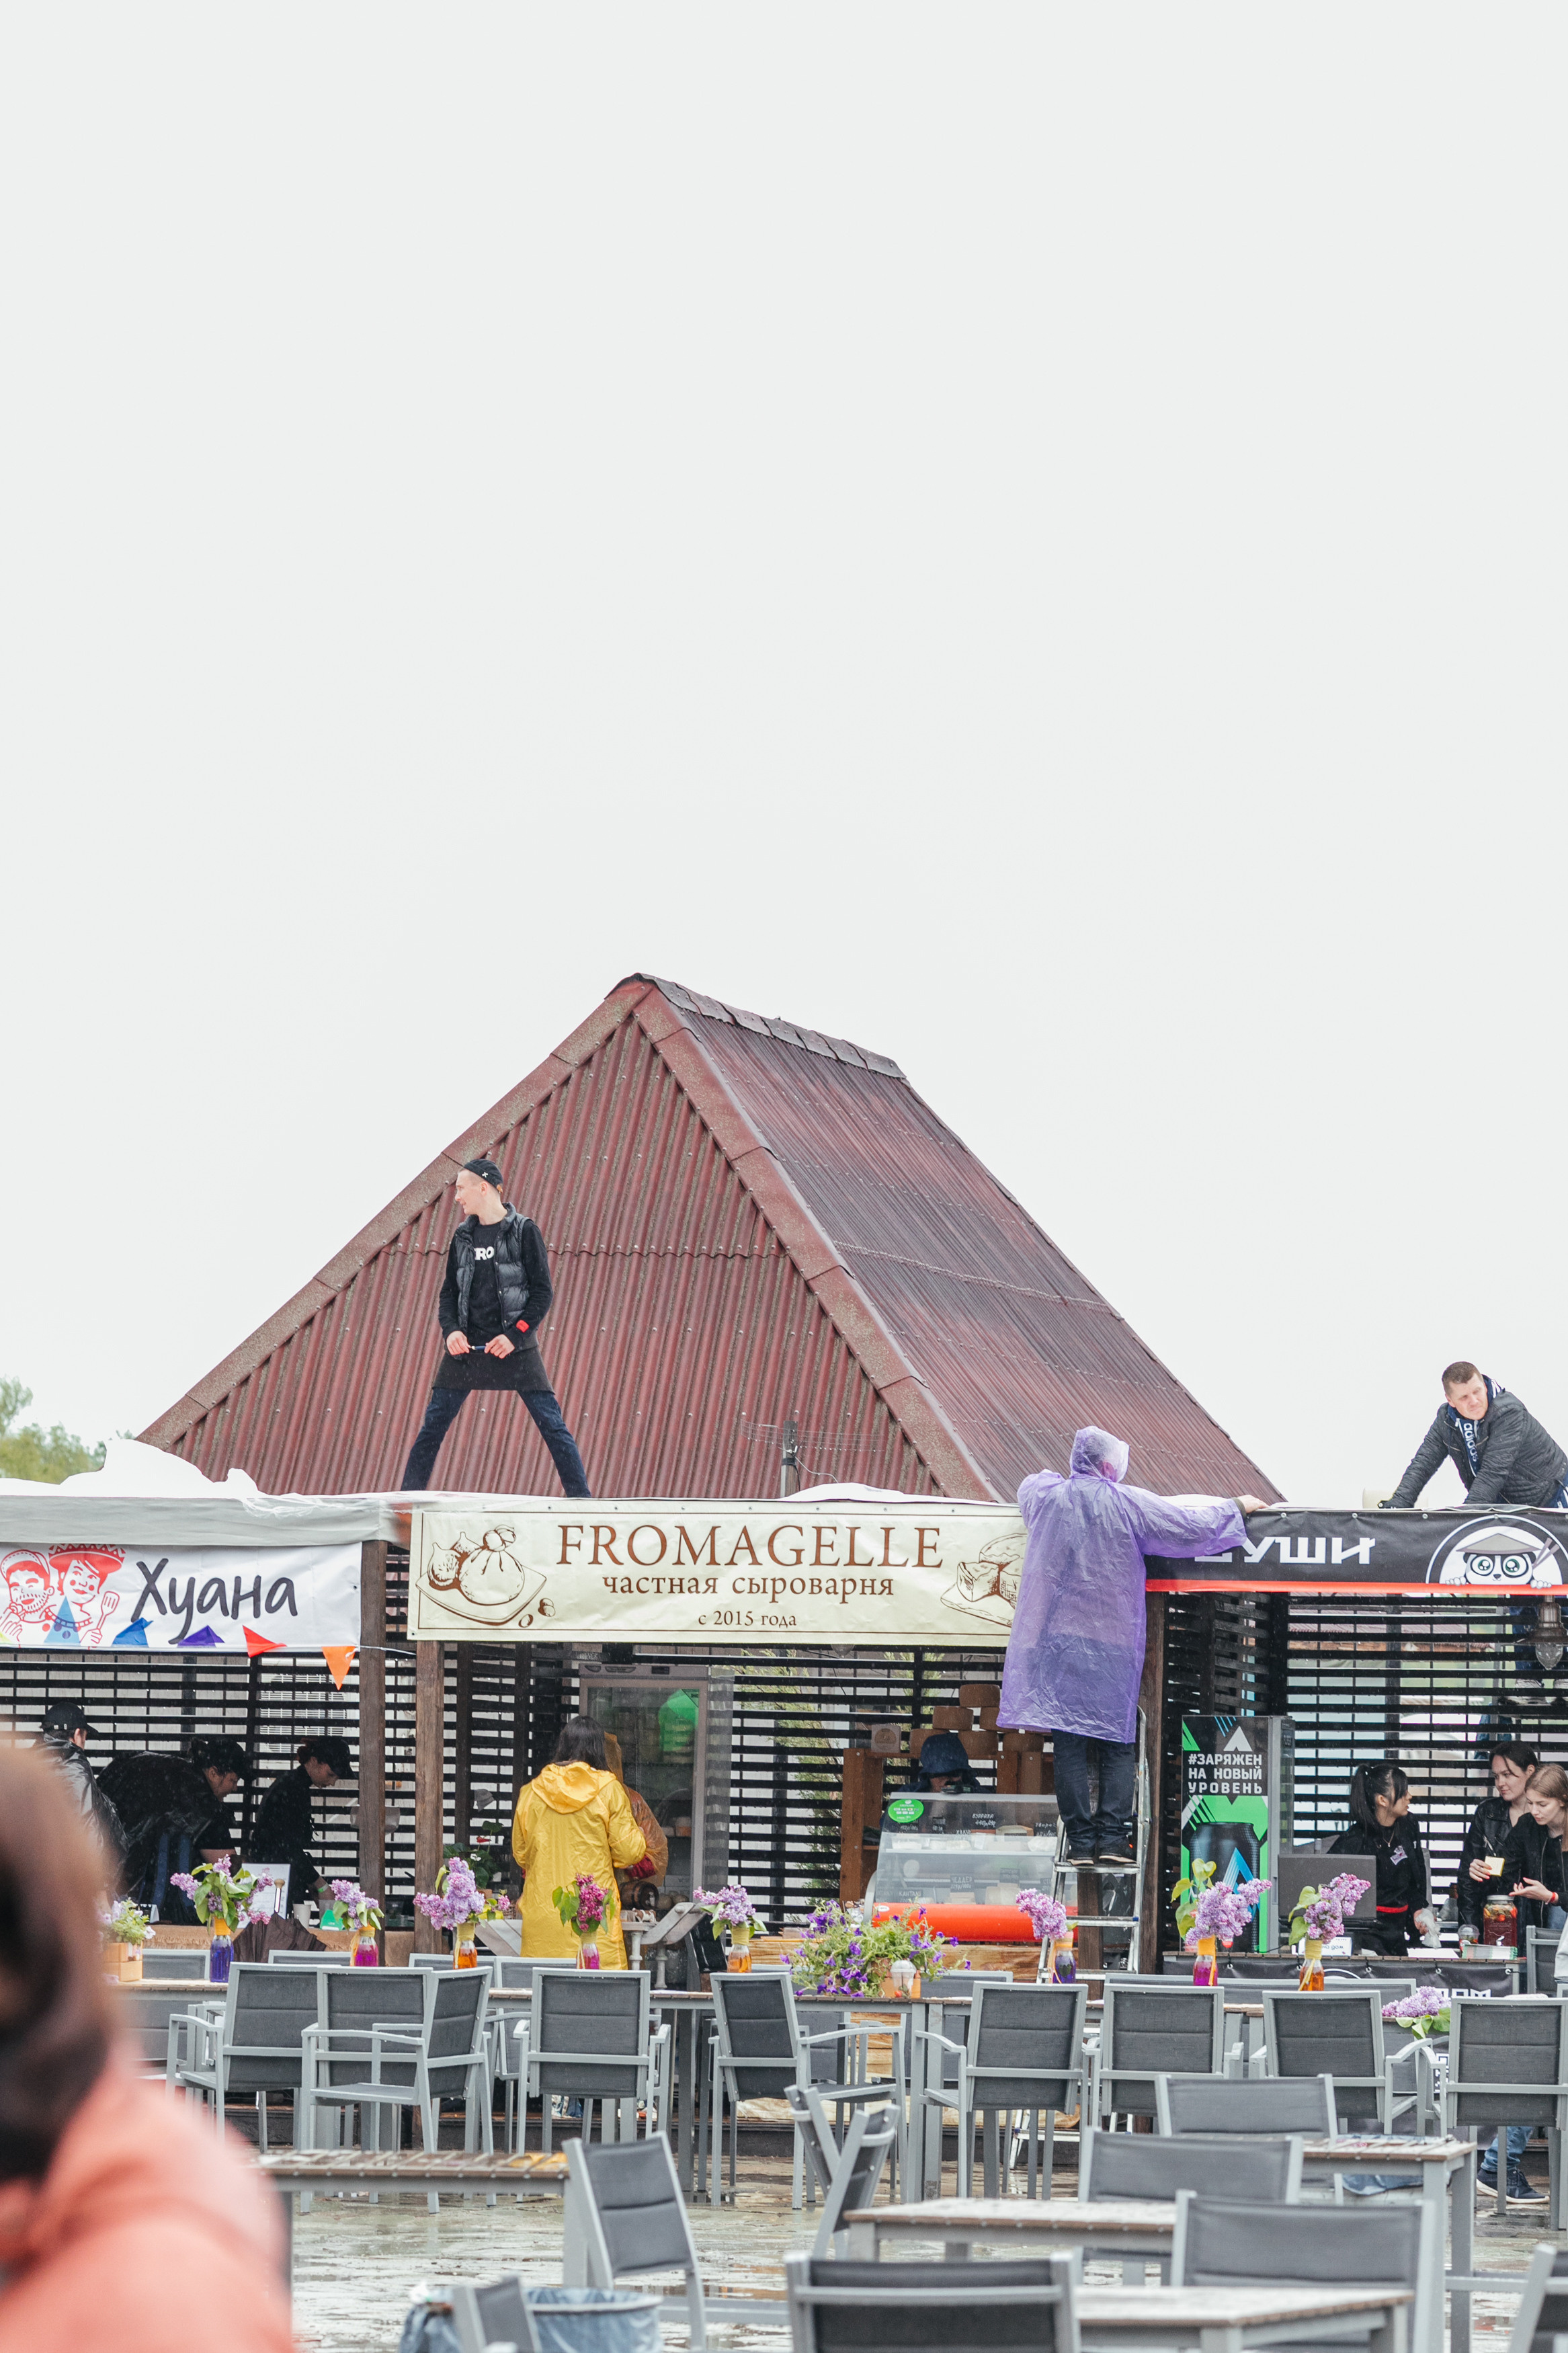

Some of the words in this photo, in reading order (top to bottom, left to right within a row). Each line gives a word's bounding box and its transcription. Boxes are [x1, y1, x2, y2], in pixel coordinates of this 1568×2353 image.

[474, 1246, 495, 1261] RO
[556, 1524, 943, 1568] FROMAGELLE
[602, 1576, 718, 1594] частная
[732, 1577, 894, 1604] сыроварня
[130, 1558, 298, 1645] Хуана
[698, 1614, 706, 1625] с
[713, 1610, 754, 1626] 2015
[761, 1615, 797, 1628] года
[1188, 1753, 1262, 1765] #ЗАРЯЖЕН
[1188, 1767, 1206, 1780] НА
[1214, 1765, 1262, 1780] НОВЫЙ
[1188, 1782, 1263, 1794] УРОВЕНЬ
